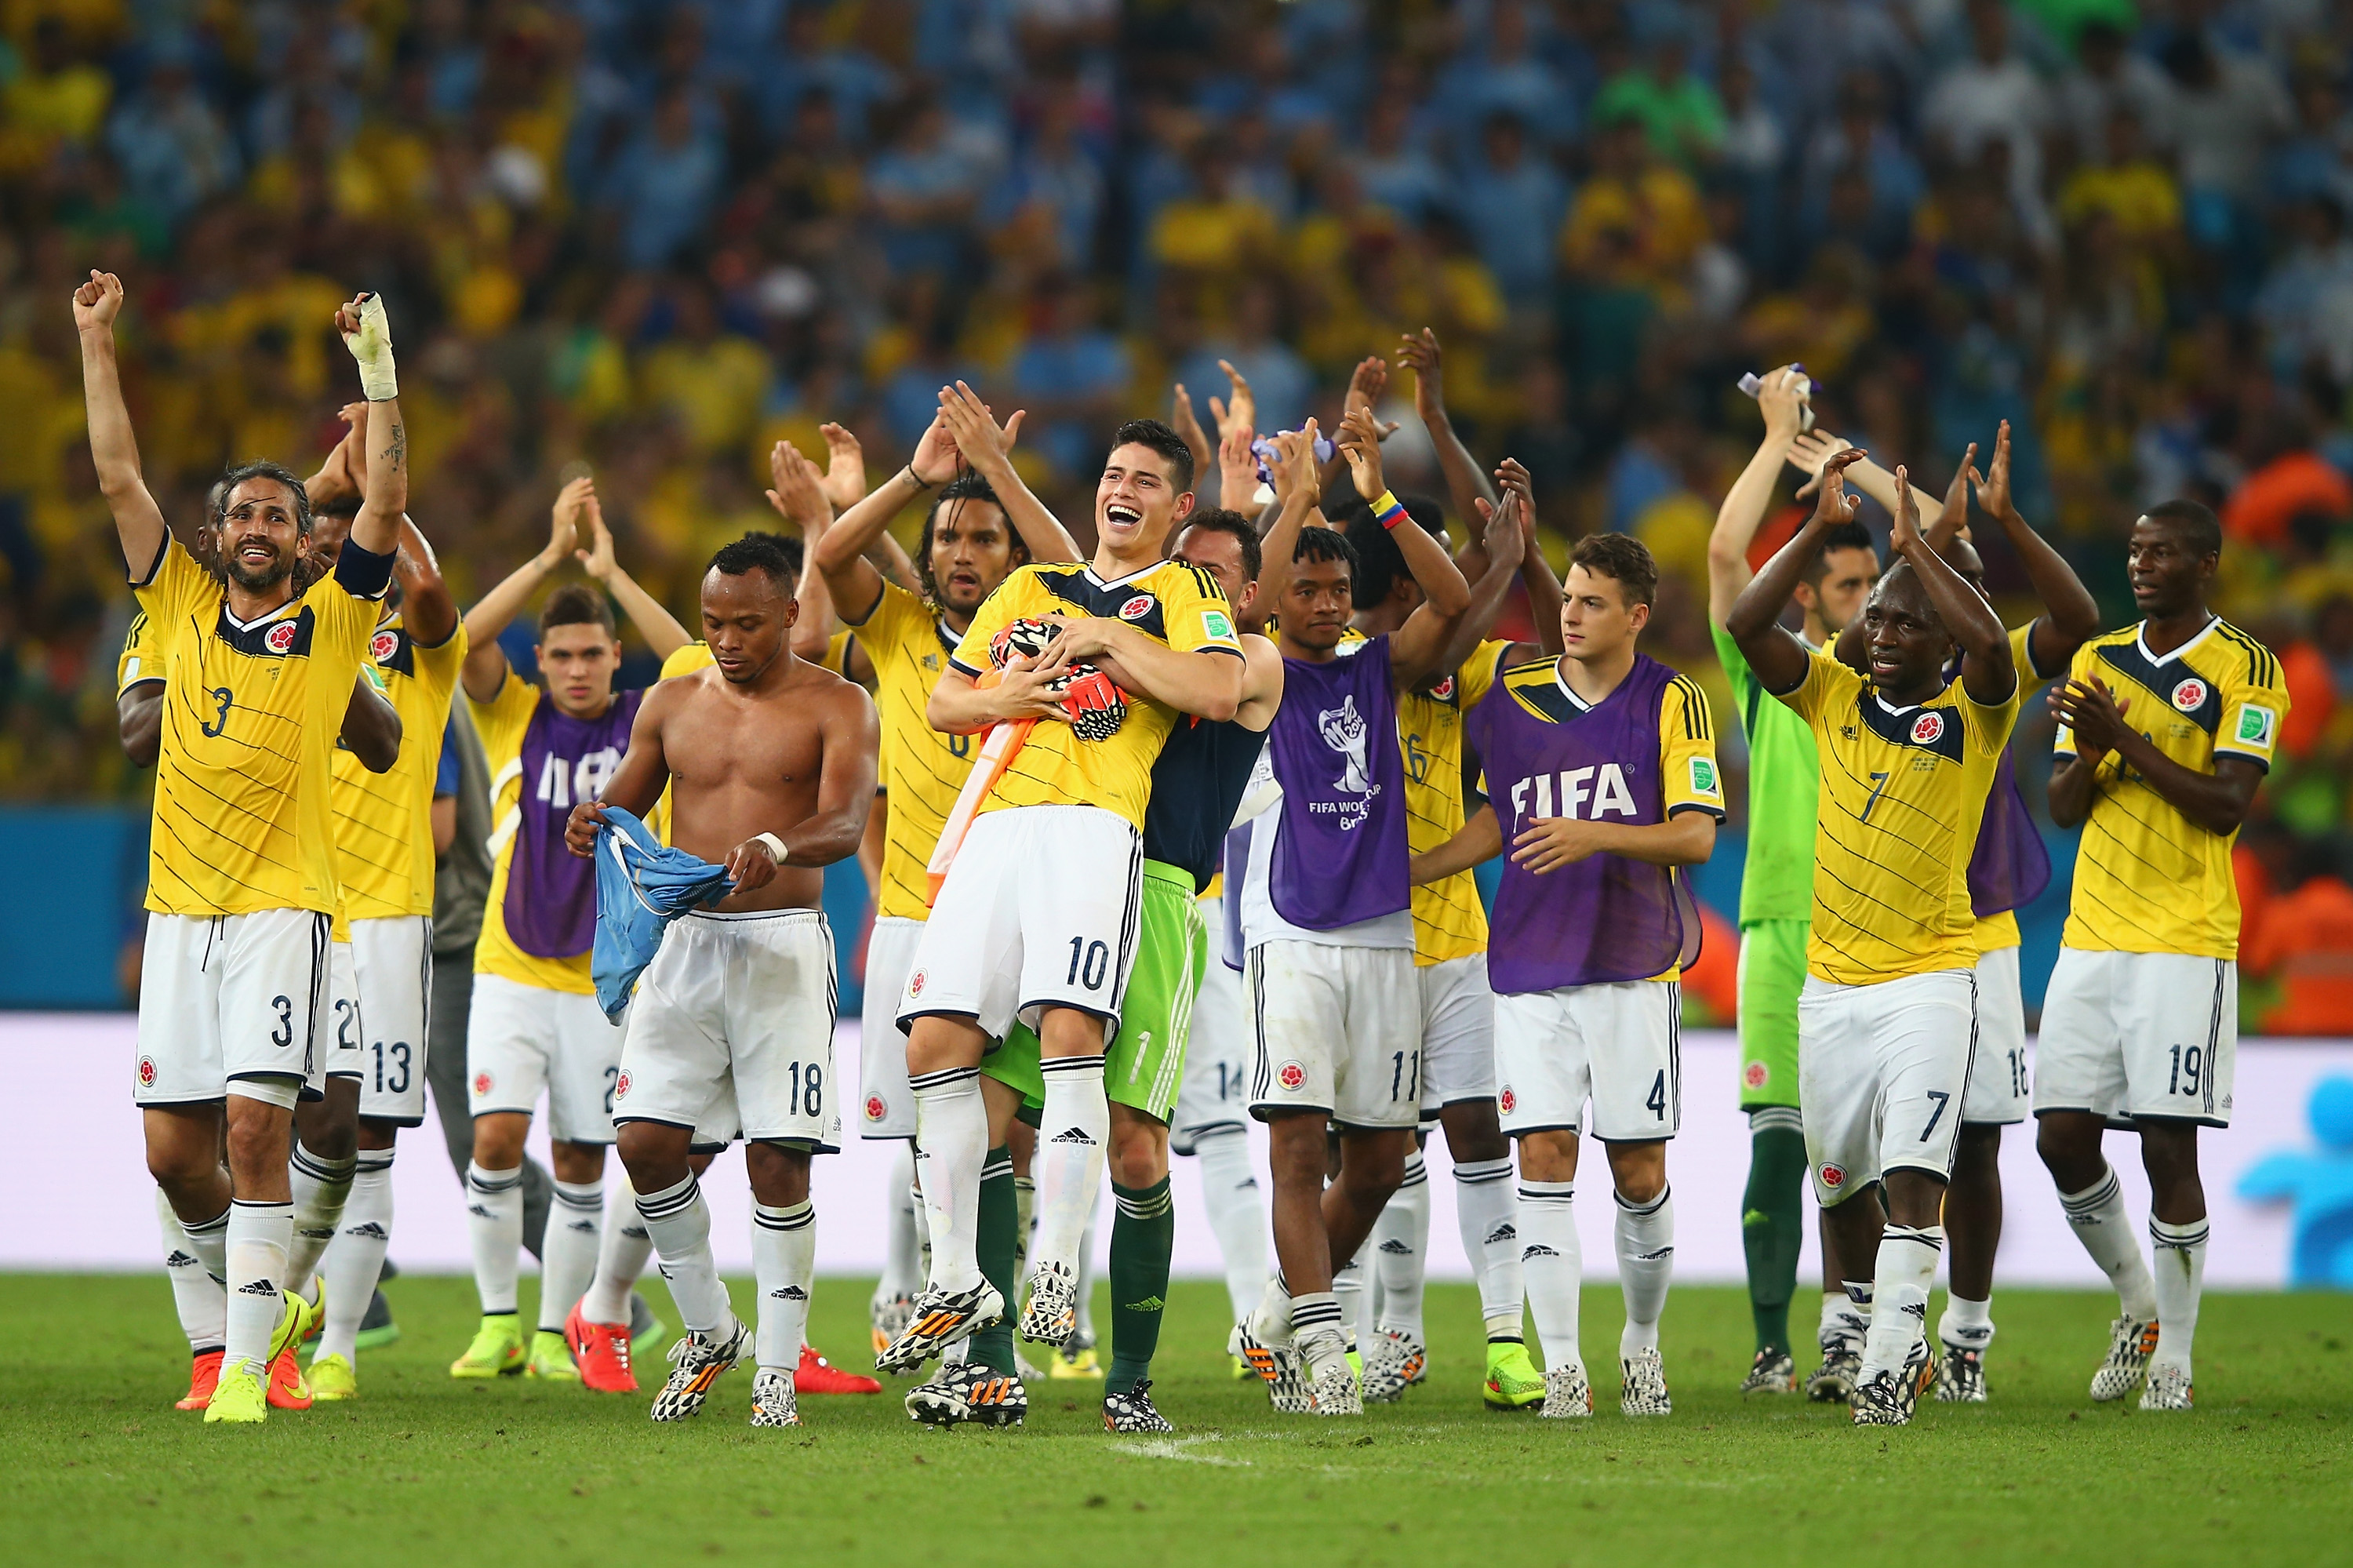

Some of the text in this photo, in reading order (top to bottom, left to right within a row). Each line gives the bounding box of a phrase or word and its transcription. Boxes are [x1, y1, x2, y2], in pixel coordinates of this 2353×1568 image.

[202, 687, 234, 738] 3
[1408, 733, 1427, 784] 6
[1309, 802, 1337, 813] FIFA
[1859, 772, 1889, 823] 7
[1067, 936, 1110, 991] 10
[271, 995, 293, 1048] 3
[335, 998, 363, 1051] 21
[371, 1041, 413, 1093] 13
[1128, 1031, 1151, 1086] 1
[1392, 1050, 1418, 1102] 11
[2169, 1042, 2202, 1097] 19
[787, 1060, 823, 1118] 18
[1646, 1068, 1666, 1121] 4
[1919, 1090, 1951, 1143] 7
